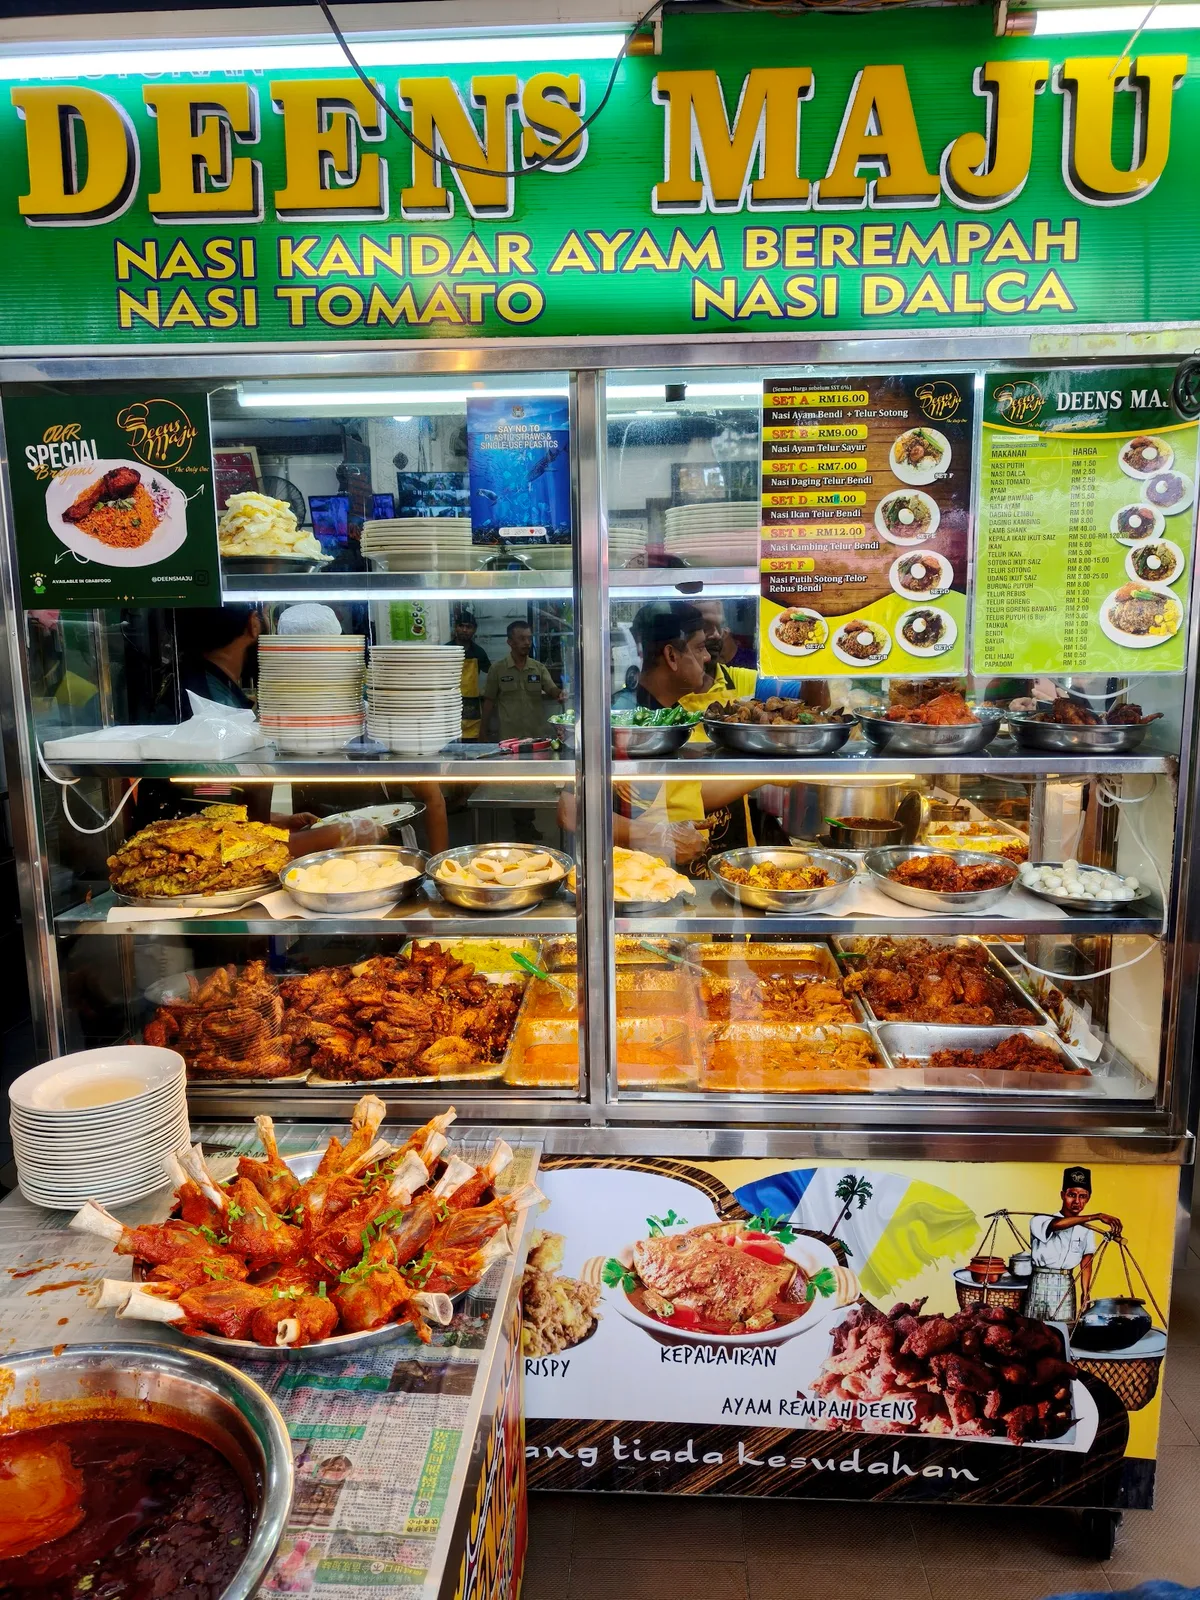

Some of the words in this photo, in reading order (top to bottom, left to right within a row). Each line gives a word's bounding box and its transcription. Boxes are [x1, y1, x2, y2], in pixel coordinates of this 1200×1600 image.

[10, 72, 588, 228] DEENS
[652, 55, 1188, 213] MAJU
[115, 237, 257, 281] NASI
[279, 232, 536, 279] KANDAR
[549, 226, 723, 274] AYAM
[743, 218, 1080, 271] BEREMPAH
[116, 285, 258, 330] NASI
[277, 281, 546, 327] TOMATO
[692, 273, 840, 321] NASI
[861, 269, 1077, 317] DALCA
[772, 396, 796, 406] SET
[799, 396, 809, 405] A
[818, 394, 865, 403] RM16.00
[1056, 390, 1122, 411] DEENS
[1130, 388, 1174, 408] MA
[772, 411, 791, 420] Nasi
[792, 411, 817, 421] Ayam
[817, 409, 843, 419] Bendi
[854, 409, 877, 418] Telur
[878, 408, 909, 419] Sotong
[43, 423, 82, 444] OUR
[498, 424, 514, 433] SAY
[515, 424, 527, 433] NO
[530, 424, 540, 432] TO
[772, 429, 796, 439] SET
[799, 429, 809, 439] B
[818, 428, 858, 437] RM9.00
[485, 433, 515, 441] PLASTIC
[516, 432, 546, 441] STRAWS
[525, 440, 559, 449] PLASTICS
[771, 444, 790, 453] Nasi
[791, 444, 815, 454] Ayam
[816, 443, 840, 453] Telur
[841, 443, 867, 453] Sayur
[25, 439, 98, 471] SPECIAL
[991, 449, 1027, 458] MAKANAN
[1072, 447, 1098, 455] HARGA
[771, 463, 795, 473] SET
[799, 463, 808, 472] C
[817, 462, 857, 471] RM7.00
[771, 477, 790, 487] Nasi
[790, 477, 821, 488] Daging
[822, 476, 846, 486] Telur
[847, 476, 872, 485] Bendi
[770, 496, 795, 505] SET
[798, 495, 808, 505] D
[770, 510, 789, 519] Nasi
[790, 510, 810, 519] Ikan
[811, 509, 835, 518] Telur
[836, 509, 861, 518] Bendi
[770, 528, 795, 538] SET
[798, 528, 807, 537] E
[816, 527, 862, 536] RM12.00
[770, 543, 789, 552] Nasi
[789, 543, 828, 553] Kambing
[829, 541, 853, 550] Telur
[853, 541, 879, 550] Bendi
[770, 561, 794, 570] SET
[796, 560, 806, 570] F
[769, 575, 788, 584] Nasi
[789, 575, 812, 584] Putih
[813, 574, 843, 584] Sotong
[844, 574, 867, 583] Telor
[769, 584, 796, 593] Rebus
[796, 583, 822, 593] Bendi
[996, 652, 1015, 660] HIJAU
[660, 1346, 730, 1365] KEPALA
[732, 1347, 777, 1366] IKAN
[525, 1358, 571, 1378] RISPY
[721, 1397, 773, 1416] AYAM
[778, 1398, 853, 1419] REMPAH
[857, 1400, 918, 1421] DEENS
[526, 1445, 599, 1467] ang
[612, 1436, 724, 1465] tiada
[738, 1441, 980, 1483] kesudahan
